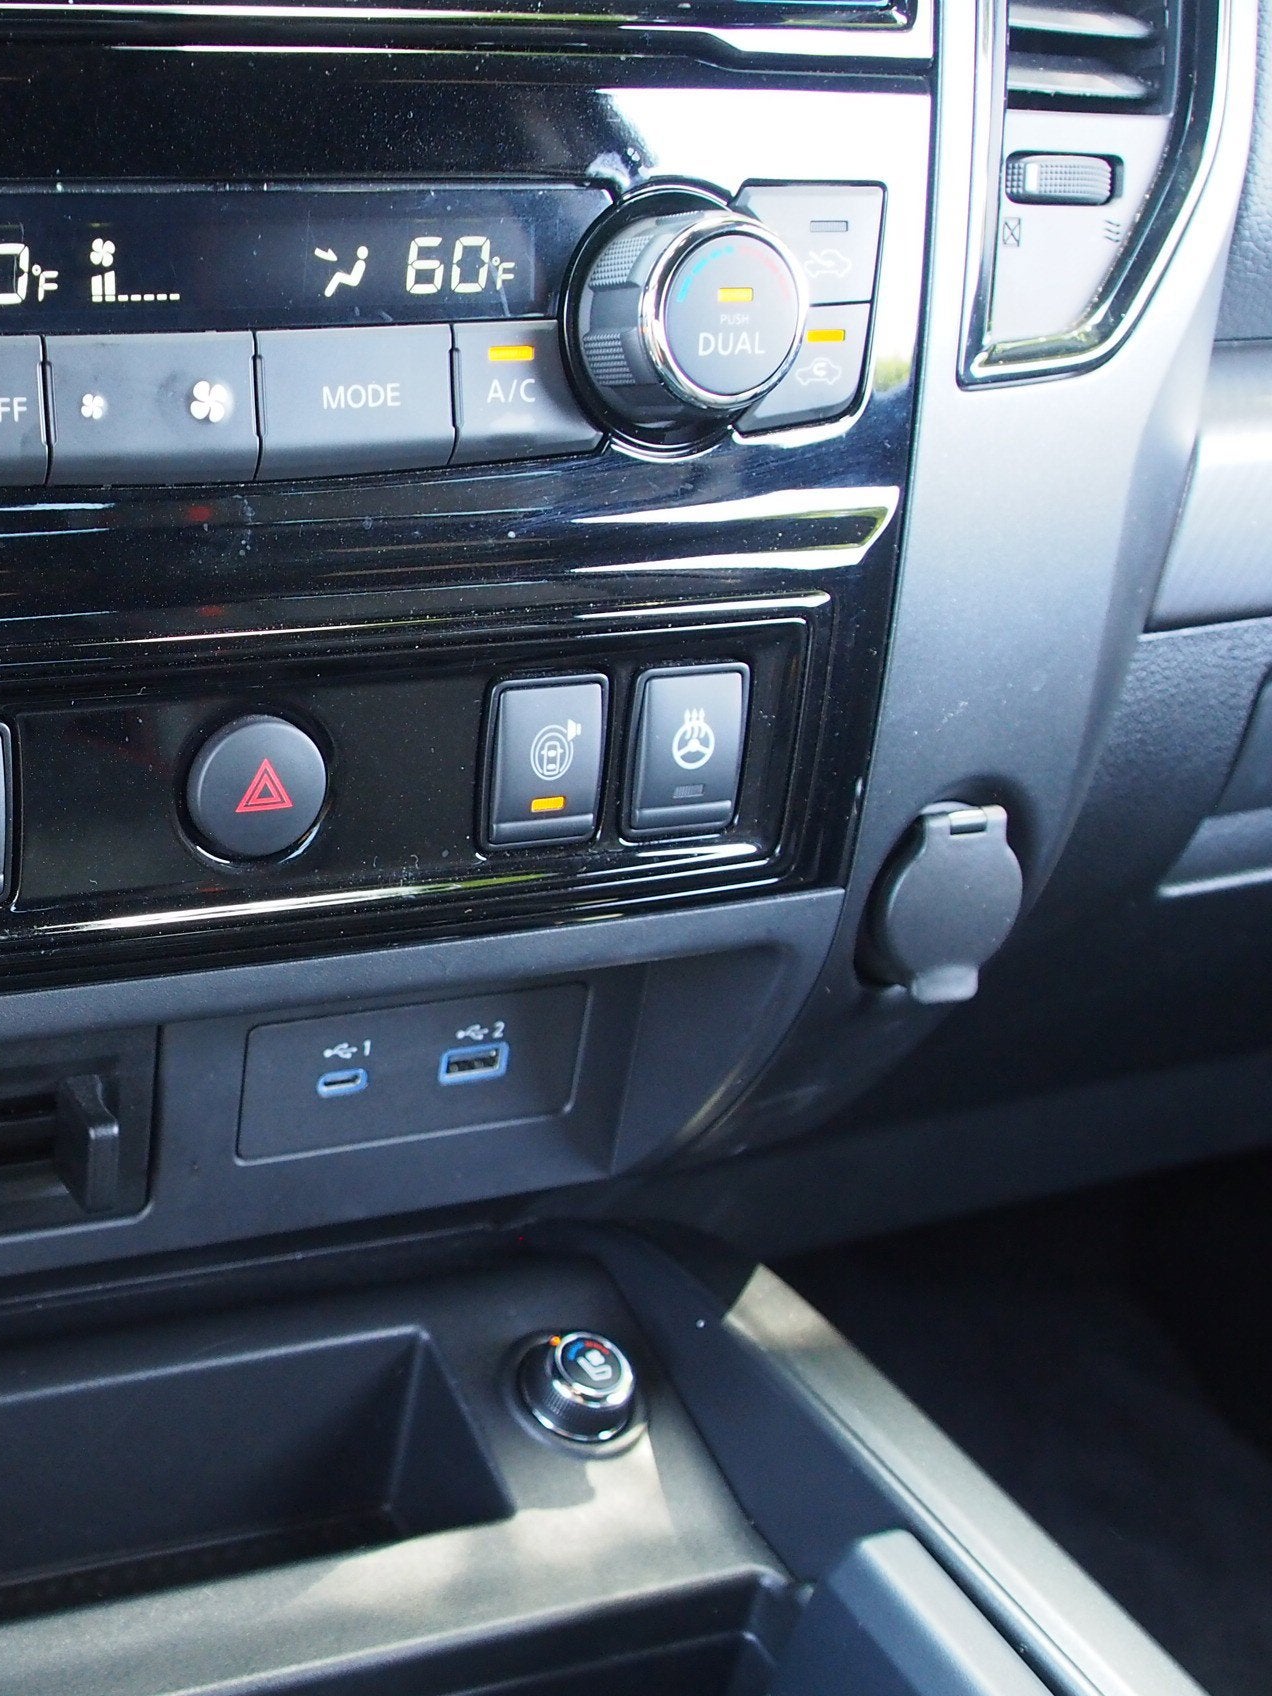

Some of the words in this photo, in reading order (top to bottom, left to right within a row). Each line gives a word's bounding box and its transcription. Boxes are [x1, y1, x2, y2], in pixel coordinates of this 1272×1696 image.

[720, 312, 750, 326] PUSH
[697, 331, 767, 357] DUAL
[321, 382, 402, 411] MODE
[485, 377, 537, 405] A/C
[492, 1020, 505, 1039] 2
